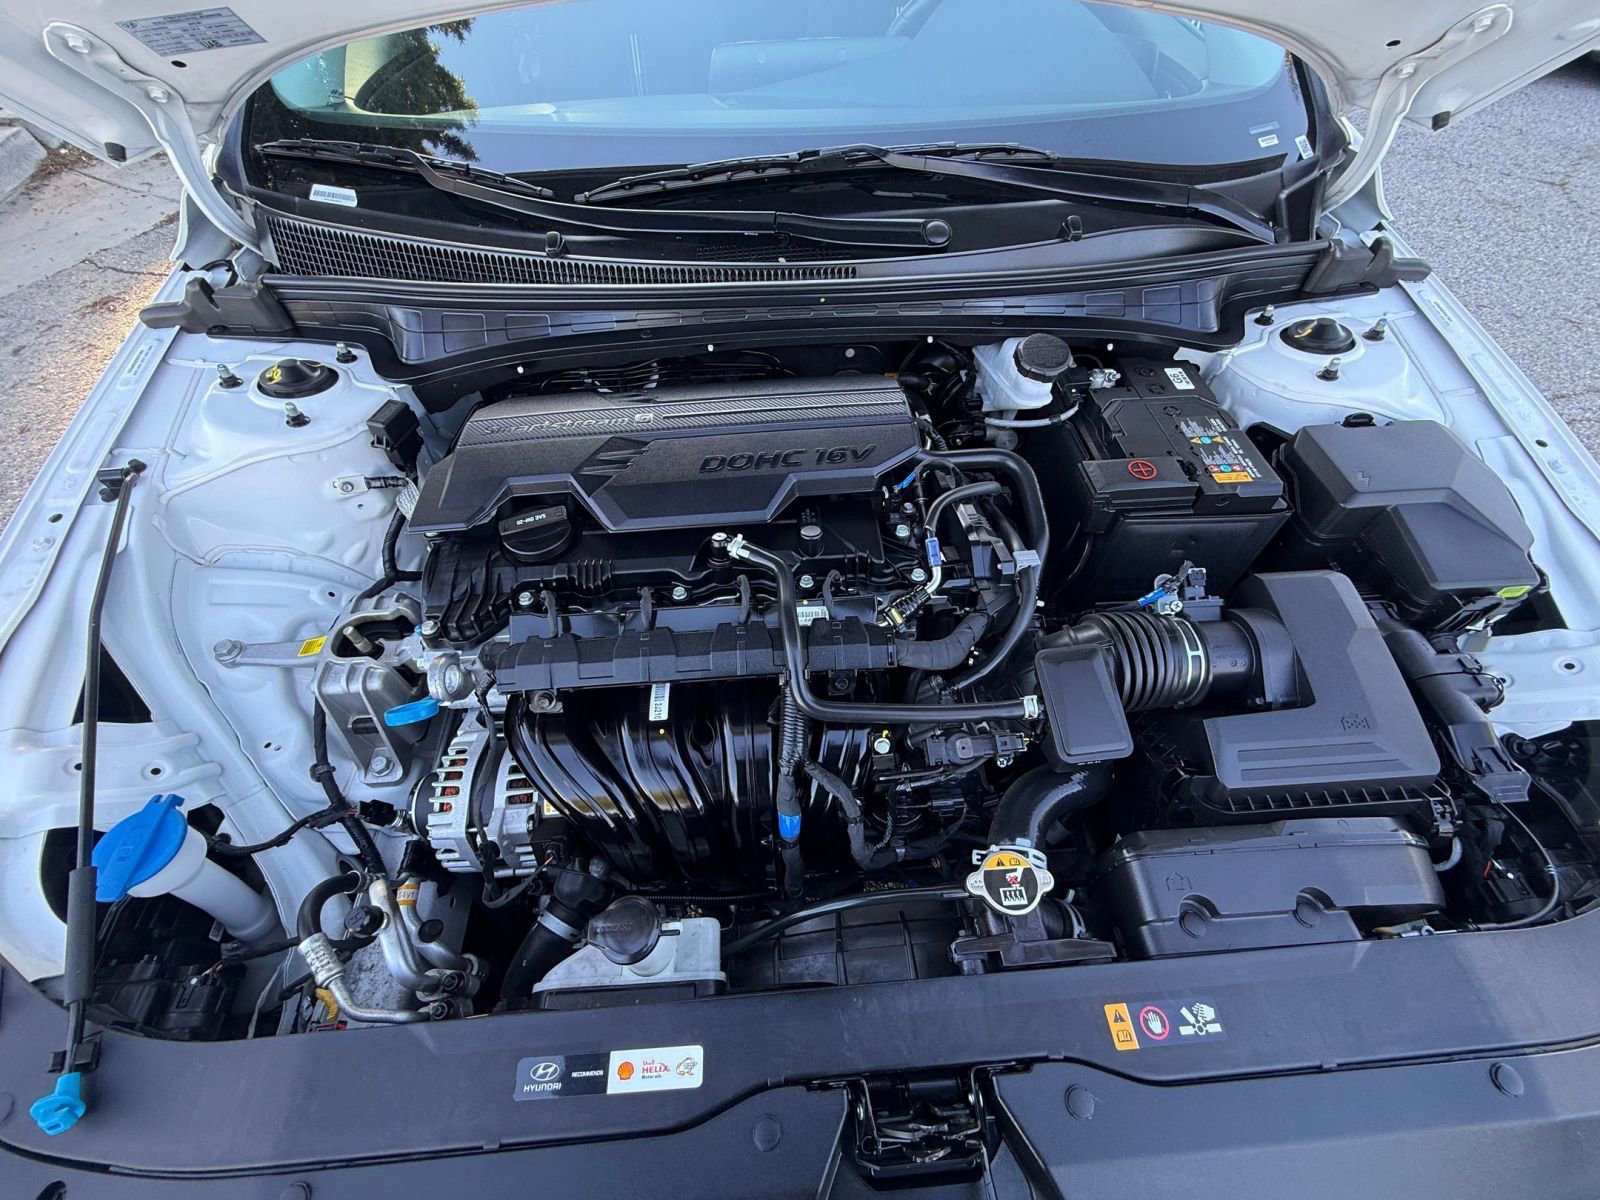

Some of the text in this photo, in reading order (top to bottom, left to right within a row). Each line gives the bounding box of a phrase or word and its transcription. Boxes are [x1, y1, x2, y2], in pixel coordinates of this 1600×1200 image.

[483, 416, 630, 436] Smartstream
[699, 443, 877, 473] DOHC 16V
[535, 513, 547, 521] SAE
[571, 1069, 604, 1078] RECOMMENDS
[641, 1065, 669, 1074] HELIX
[523, 1081, 562, 1093] HYUNDAI
